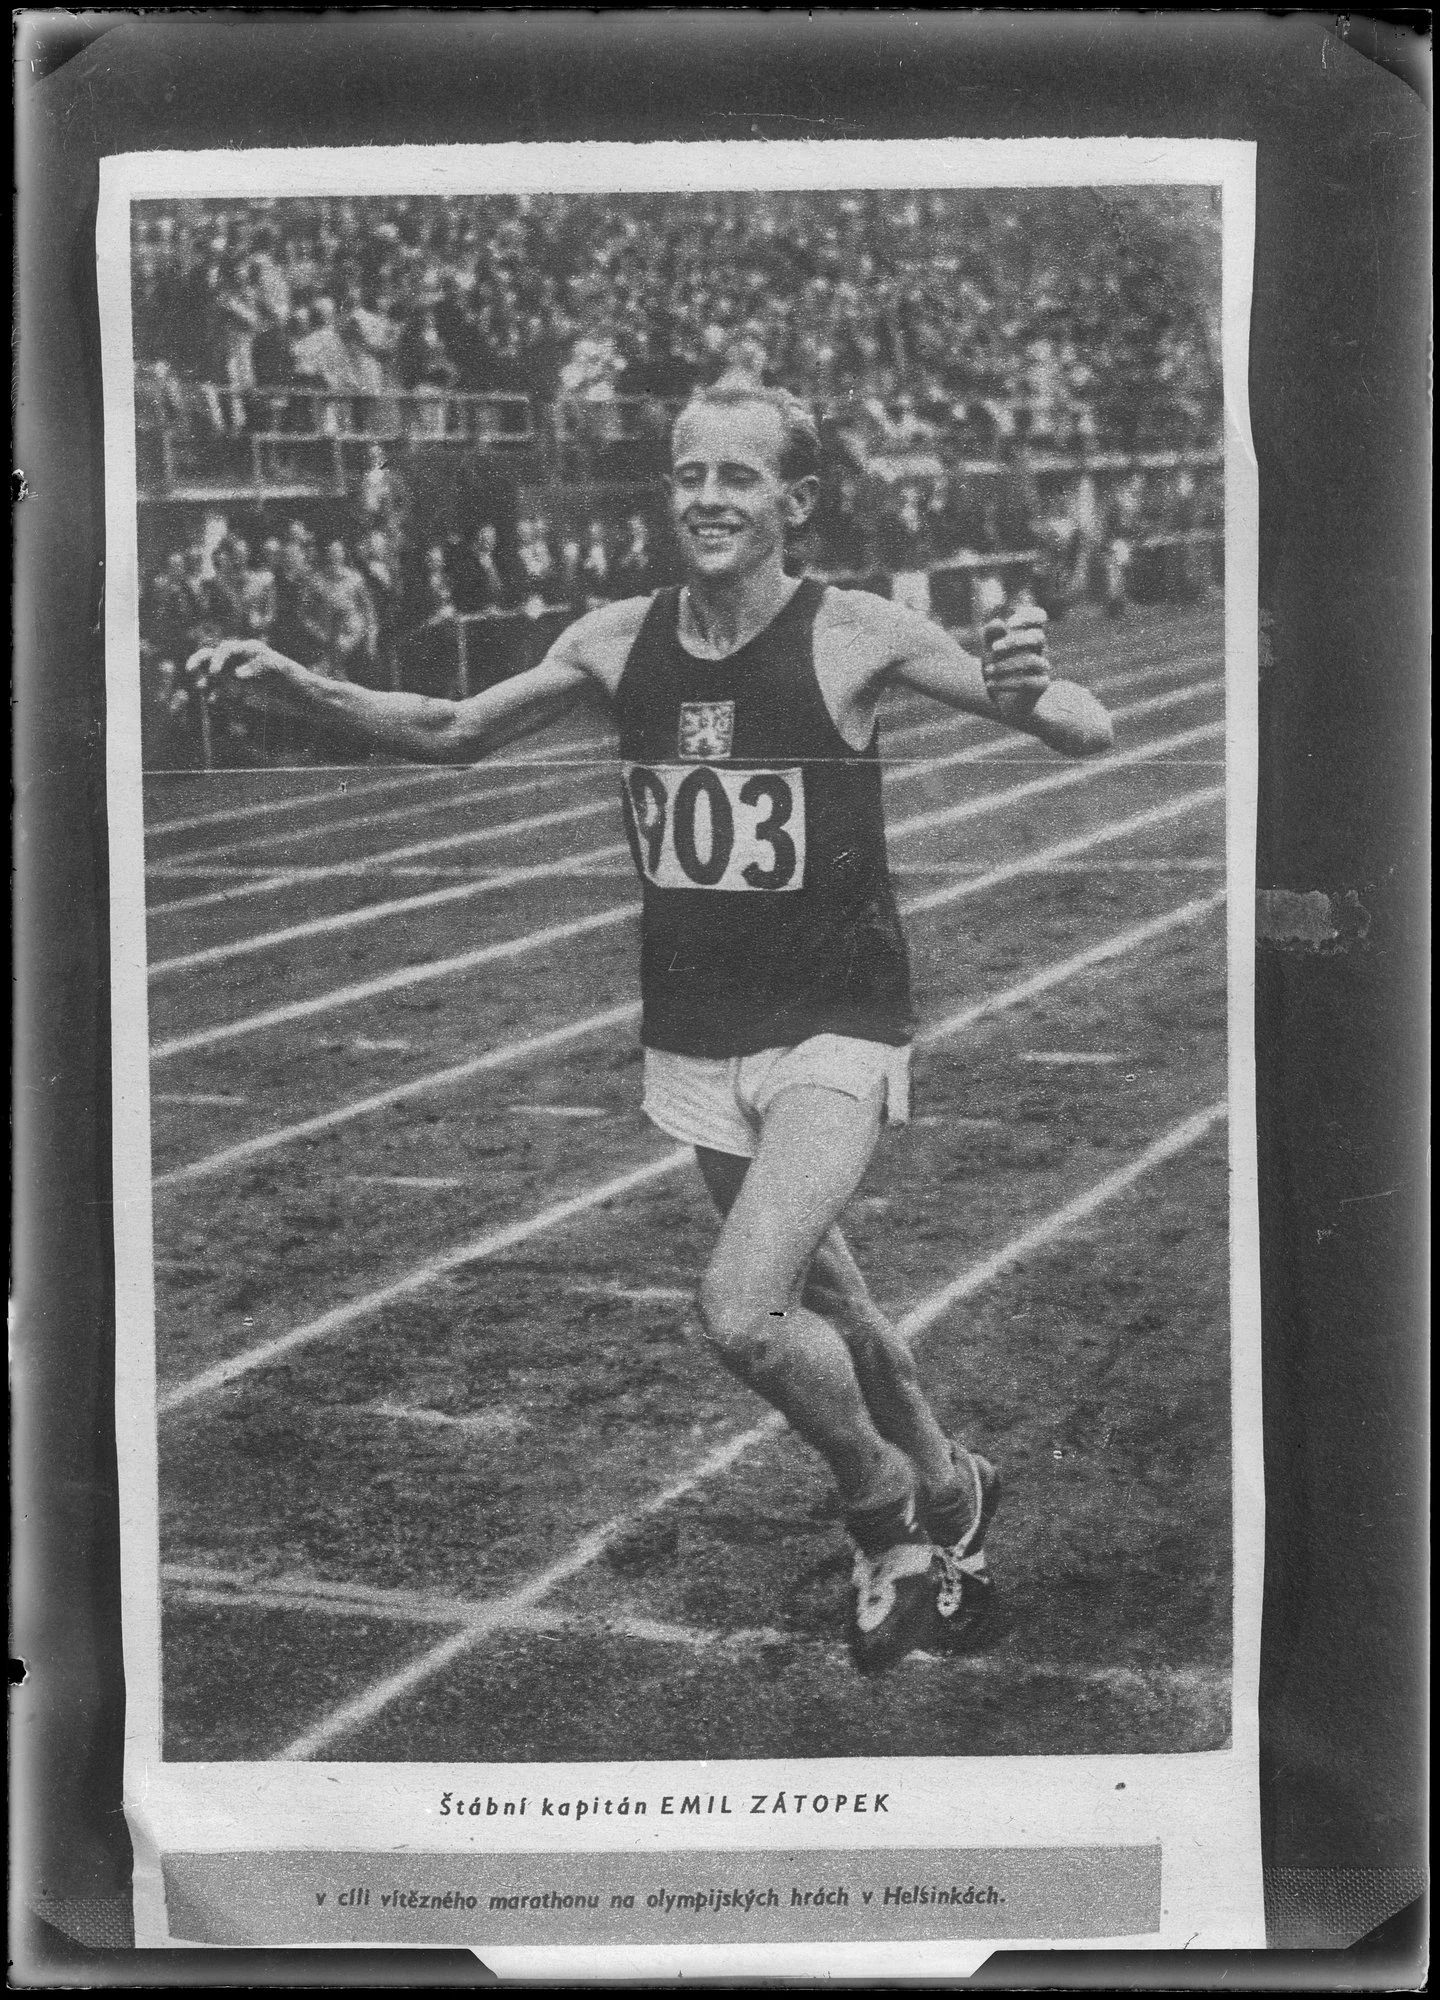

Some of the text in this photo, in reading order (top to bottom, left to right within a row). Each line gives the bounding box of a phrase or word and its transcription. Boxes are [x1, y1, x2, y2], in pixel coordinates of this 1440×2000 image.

[440, 1791, 889, 1821] Štábní kapitán EMIL ZÁTOPEK
[316, 1892, 327, 1906] v
[381, 1889, 478, 1910] vítězného
[489, 1891, 599, 1910] marathonu
[609, 1894, 635, 1909] na
[647, 1888, 779, 1914] olympijských
[791, 1887, 849, 1907] hrách
[862, 1891, 873, 1905] v
[883, 1885, 1006, 1906] Helsinkách.
